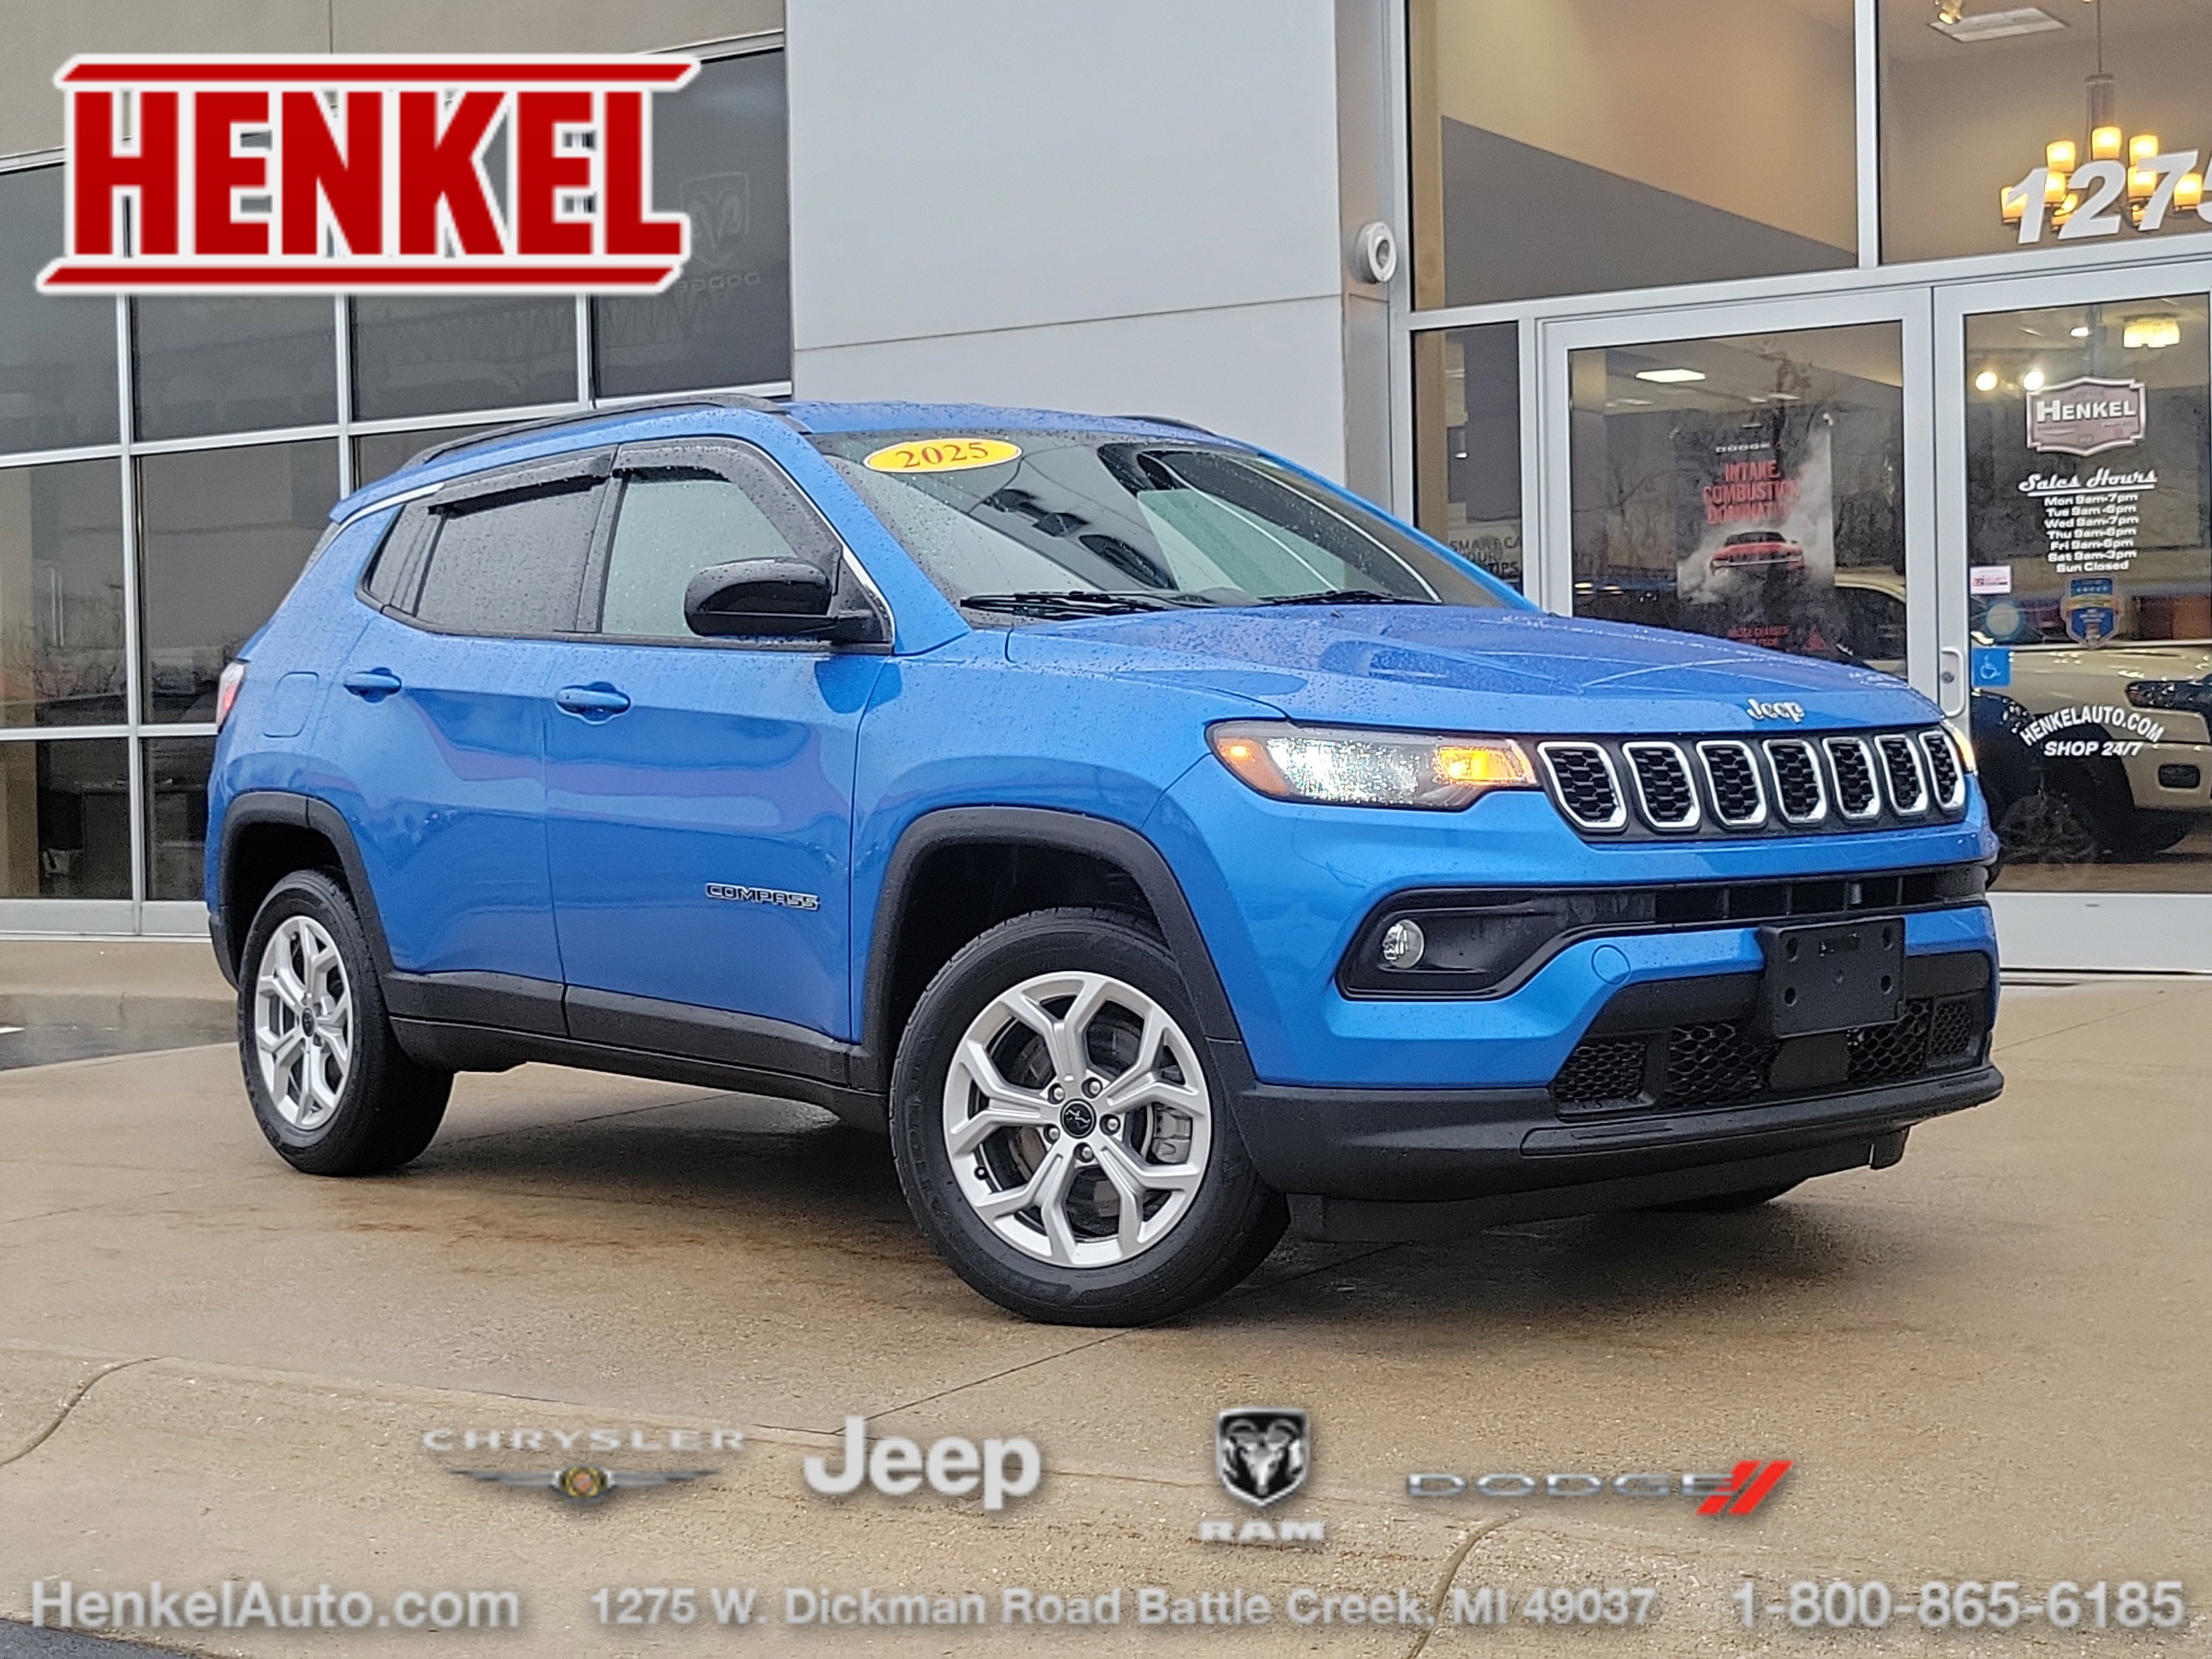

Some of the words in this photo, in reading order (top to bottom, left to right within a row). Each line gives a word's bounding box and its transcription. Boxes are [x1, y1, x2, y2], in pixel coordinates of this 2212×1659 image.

[2006, 148, 2212, 244] 127
[2036, 399, 2137, 422] HENKEL
[895, 442, 989, 468] 2025
[2018, 473, 2081, 492] Sales
[2086, 467, 2158, 488] Hours
[2044, 496, 2074, 507] Mon
[2045, 507, 2070, 518] Tue
[2044, 517, 2074, 529] Wed
[2046, 529, 2073, 540] Thu
[2050, 540, 2070, 551] Fri
[2047, 552, 2073, 563] Sat
[2056, 563, 2083, 573] Sun
[2084, 560, 2130, 572] Closed
[1747, 698, 1805, 723] Jeep
[2019, 704, 2165, 747] HENKELAUTO.COM
[2043, 741, 2100, 757] SHOP
[2101, 741, 2144, 757] 24/7
[706, 882, 821, 911] COMPASS
